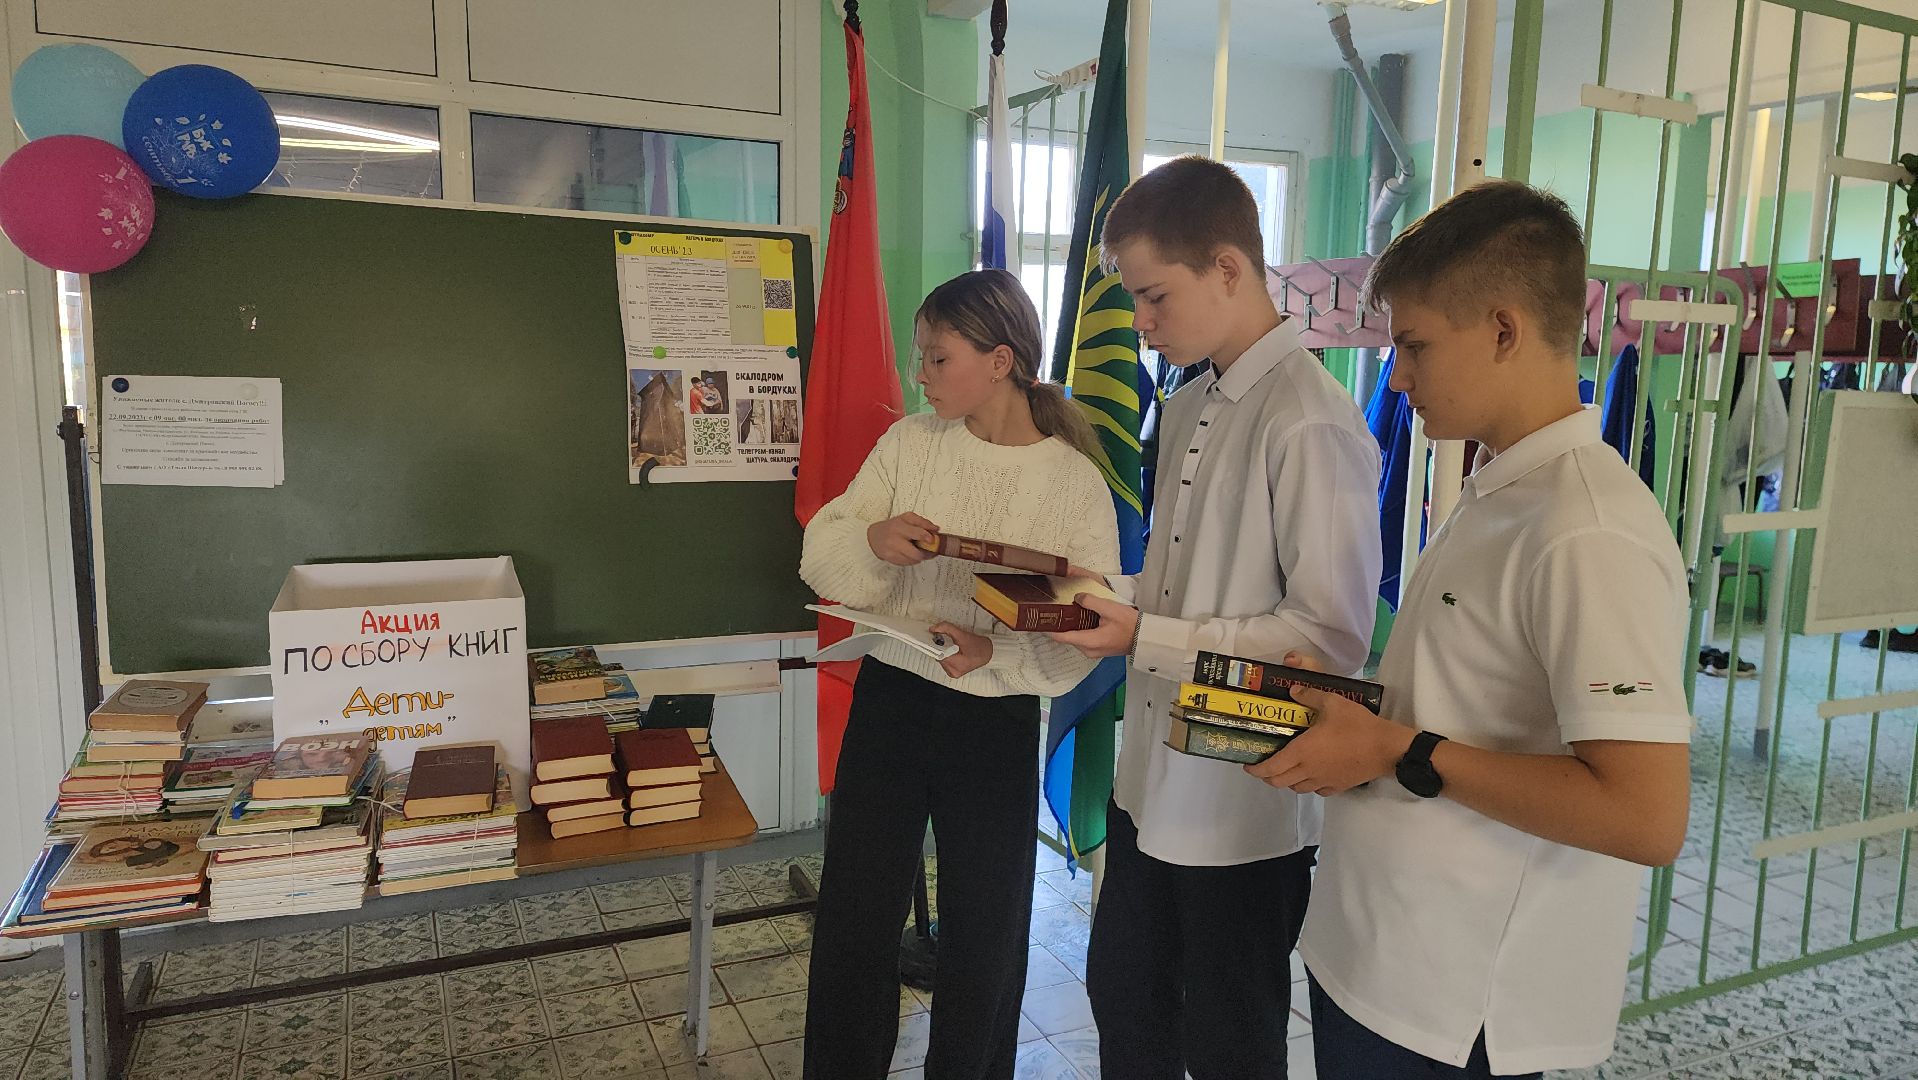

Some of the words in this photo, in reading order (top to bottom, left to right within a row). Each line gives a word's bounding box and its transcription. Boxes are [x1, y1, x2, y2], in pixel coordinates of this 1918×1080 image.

[735, 372, 784, 382] СКАЛОДРОМ
[748, 385, 755, 395] В
[757, 385, 797, 396] БОРДУКАХ
[283, 645, 333, 675] ПО
[341, 636, 431, 669] СБОРУ
[448, 627, 518, 659] КНИГ
[1237, 699, 1297, 723] ДЮМА
